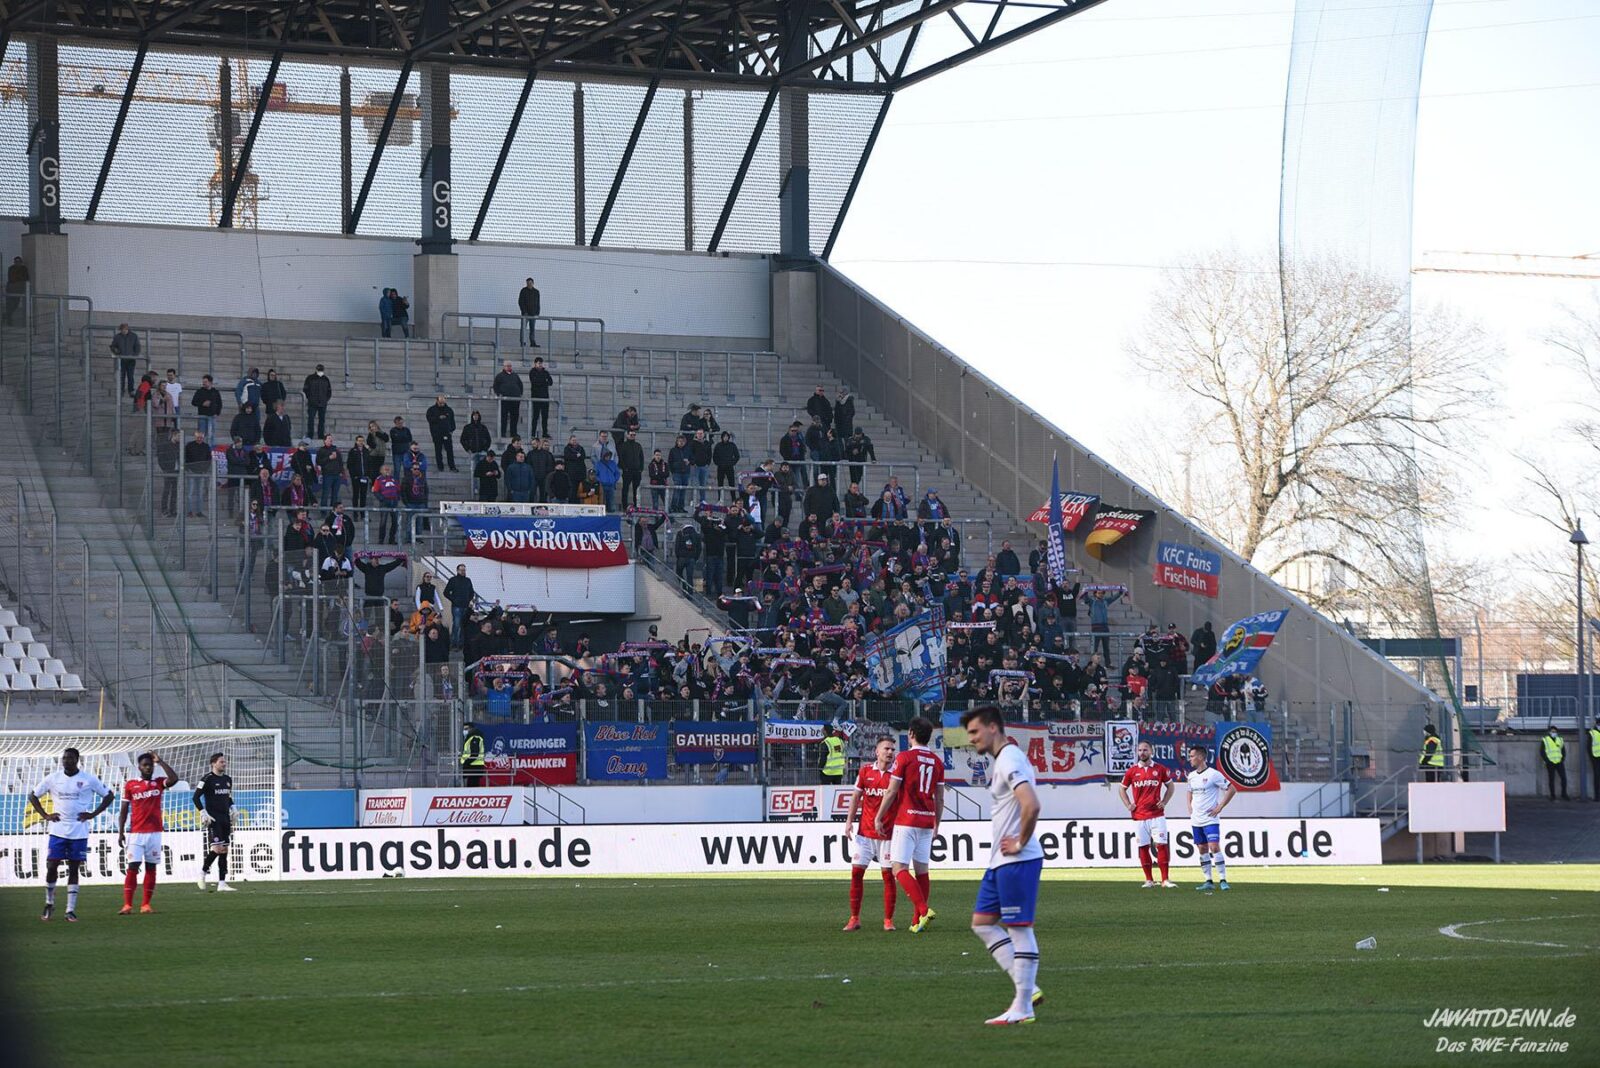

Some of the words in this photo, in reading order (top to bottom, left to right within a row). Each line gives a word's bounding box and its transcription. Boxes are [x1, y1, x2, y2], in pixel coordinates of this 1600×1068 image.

[490, 529, 603, 551] OSTGROTEN
[1162, 546, 1183, 565] KFC
[1186, 552, 1212, 572] Fans
[1164, 567, 1207, 590] Fischeln
[594, 725, 630, 741] Blue
[631, 725, 657, 740] Red
[766, 724, 807, 740] Jugend
[1087, 724, 1105, 735] Sü
[509, 738, 567, 749] UERDINGER
[511, 758, 567, 769] HALUNKEN
[607, 755, 648, 776] Army
[919, 764, 934, 794] 11
[1133, 780, 1159, 788] HARFID
[368, 798, 405, 808] TRANSPORTE
[435, 797, 507, 807] TRANSPORTE
[368, 811, 397, 825] Müller
[436, 810, 493, 824] Müller
